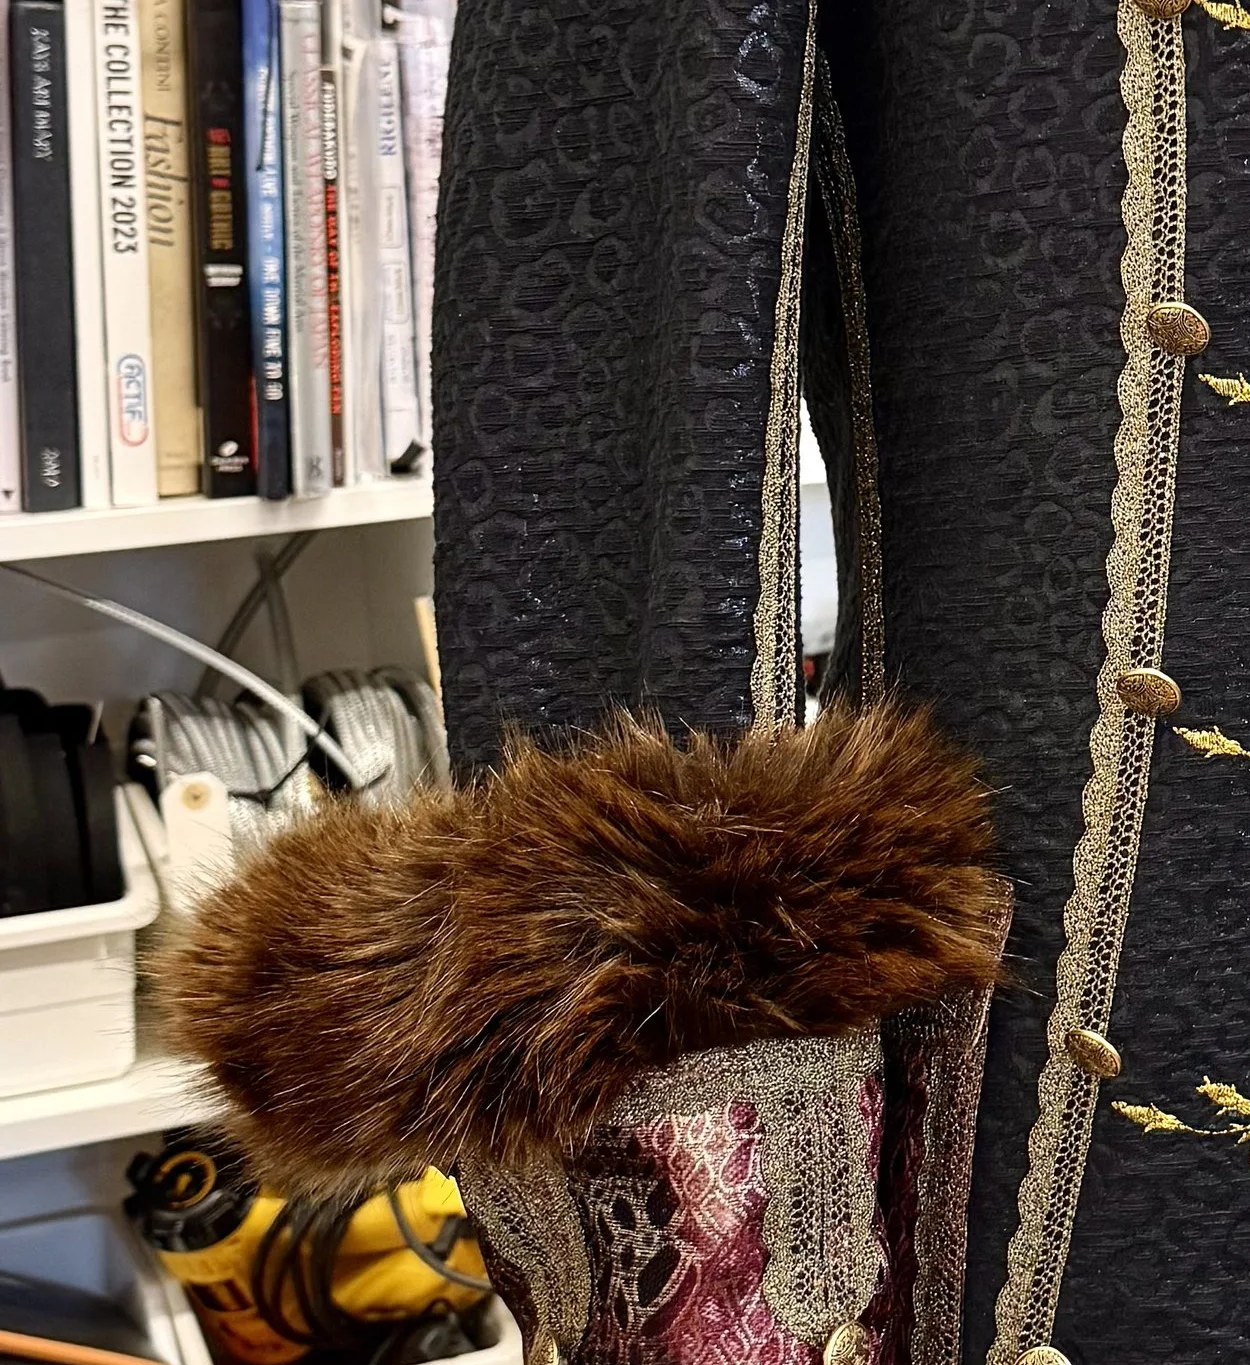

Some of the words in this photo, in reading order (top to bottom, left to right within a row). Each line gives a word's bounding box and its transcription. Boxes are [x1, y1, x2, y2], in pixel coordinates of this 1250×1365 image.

[104, 42, 137, 189] COLLECTION
[144, 113, 188, 247] Fashion
[111, 196, 139, 255] 2023
